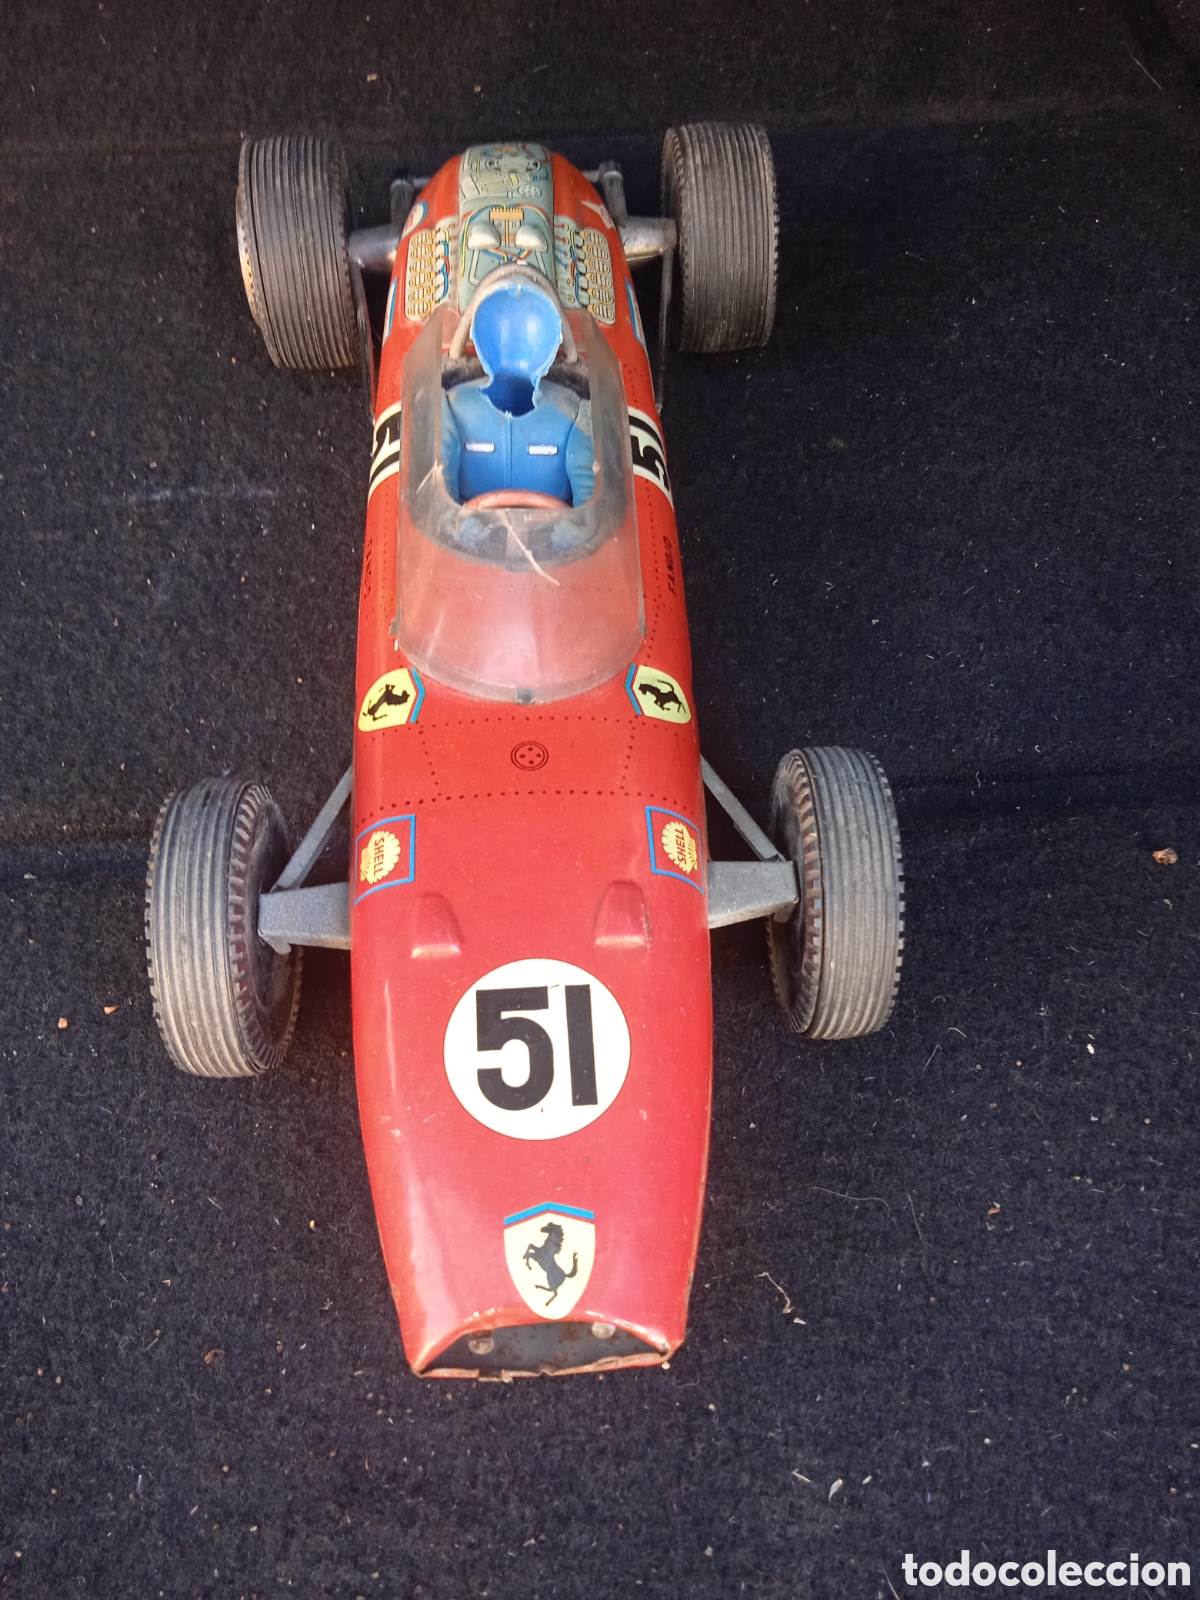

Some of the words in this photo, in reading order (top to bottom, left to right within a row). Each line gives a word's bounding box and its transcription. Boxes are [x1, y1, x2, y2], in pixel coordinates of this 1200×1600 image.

[627, 414, 670, 492] 51
[373, 837, 385, 877] SHELL
[675, 828, 687, 865] SHELL
[476, 984, 598, 1111] 51
